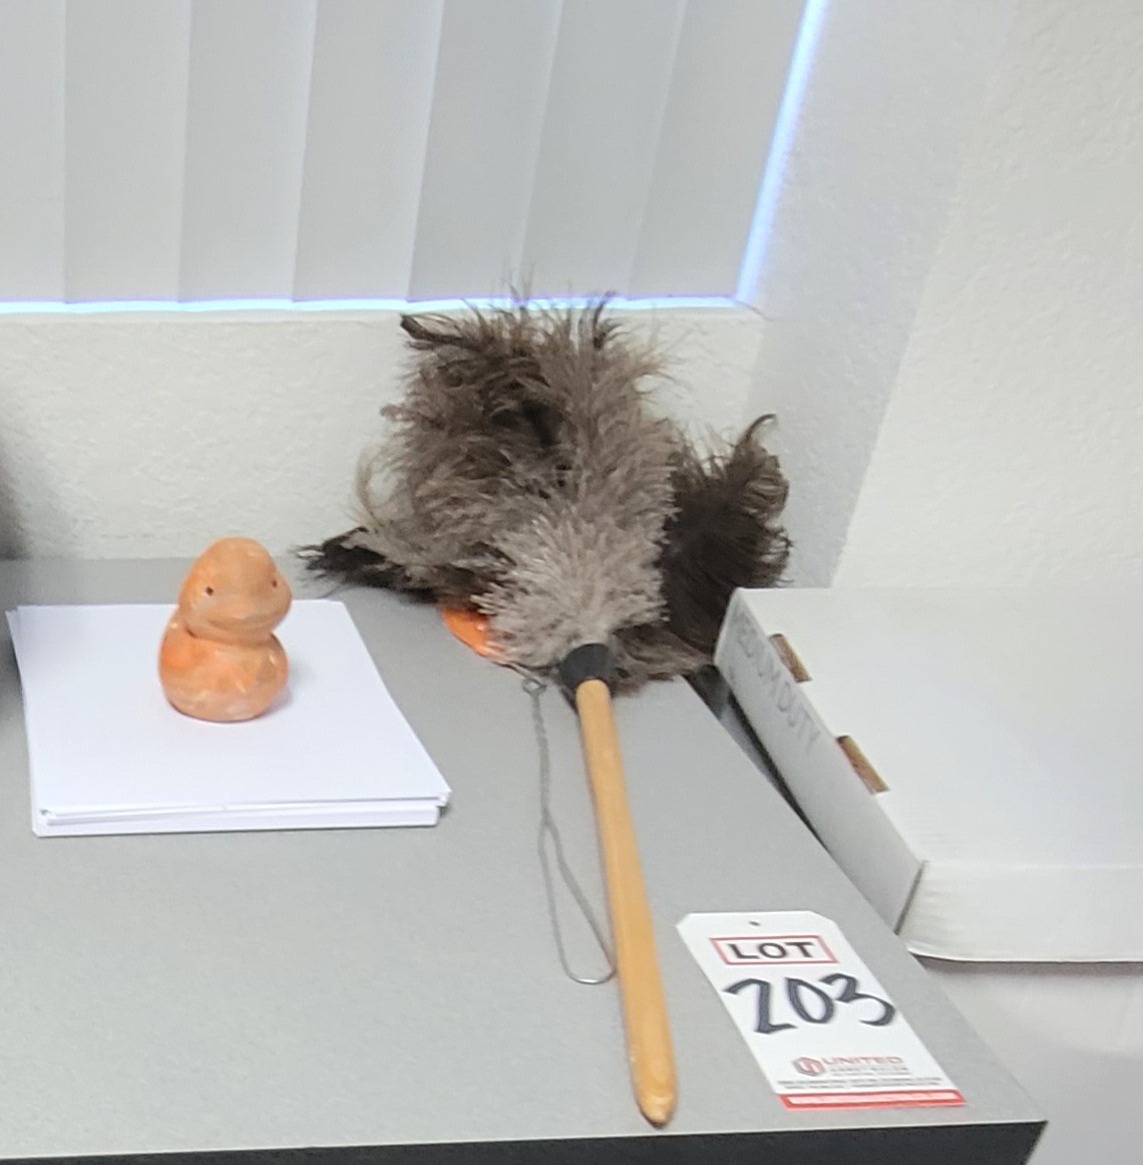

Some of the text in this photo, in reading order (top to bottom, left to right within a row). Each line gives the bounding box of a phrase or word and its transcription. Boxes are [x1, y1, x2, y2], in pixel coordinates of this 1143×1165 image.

[727, 941, 815, 959] LOT
[722, 972, 896, 1035] 203
[821, 1056, 904, 1066] UNITED
